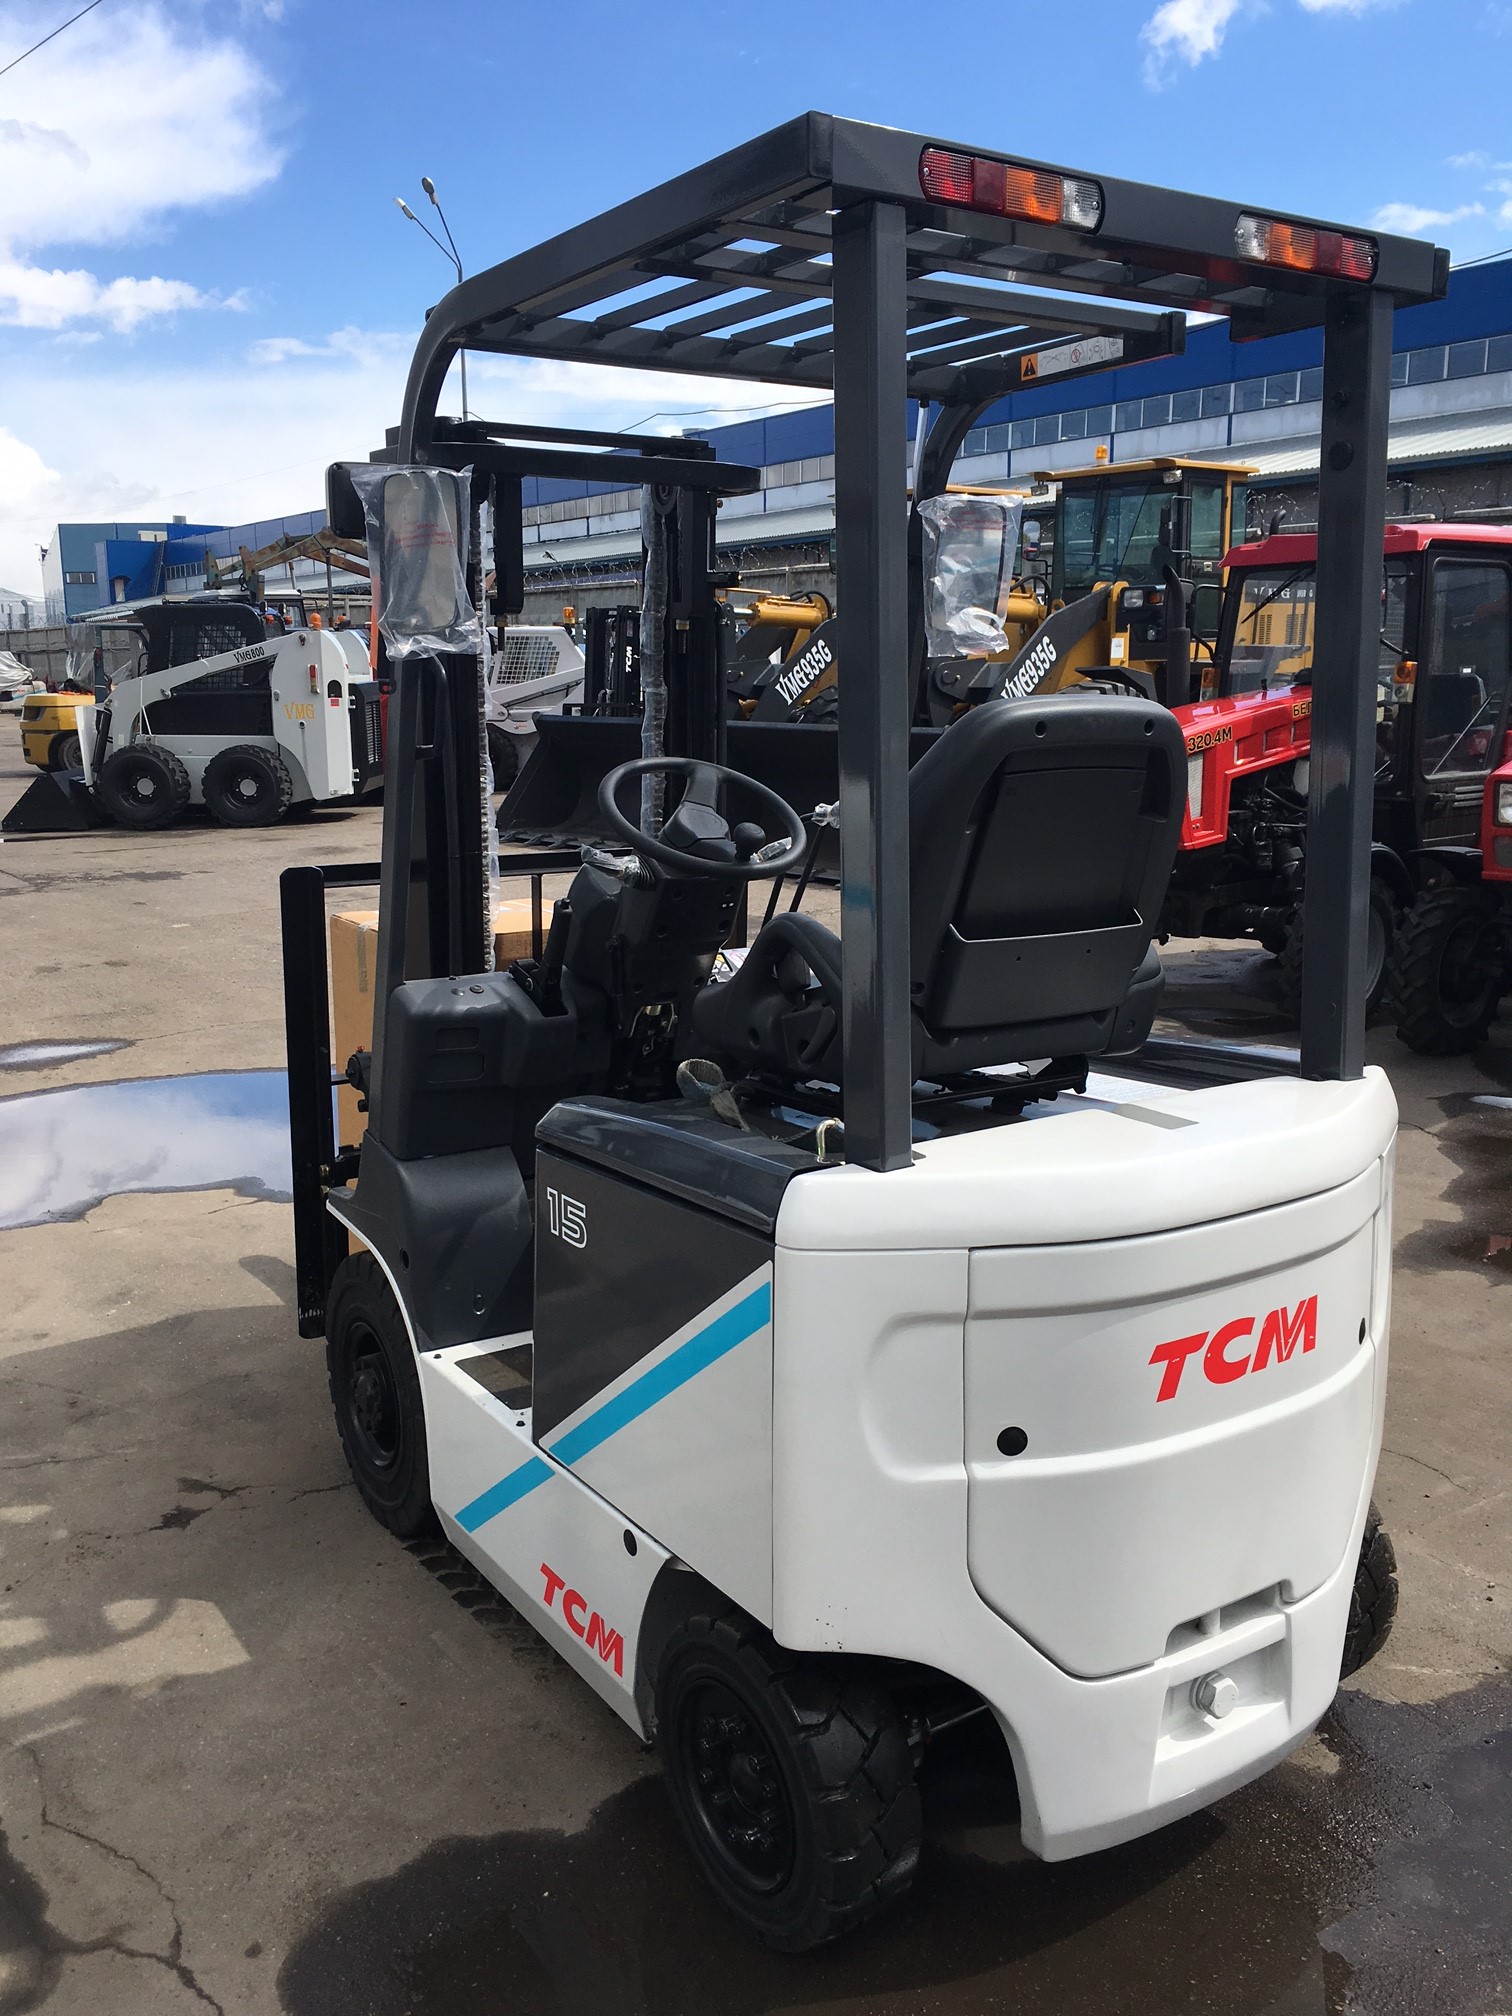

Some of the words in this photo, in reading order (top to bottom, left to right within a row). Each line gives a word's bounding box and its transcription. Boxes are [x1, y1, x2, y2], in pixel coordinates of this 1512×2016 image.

[233, 646, 265, 663] VMG800
[775, 639, 832, 706] VMG935G
[1000, 636, 1057, 699] VMG935G
[284, 701, 315, 719] VMG
[547, 1187, 587, 1248] 15
[1148, 1295, 1318, 1403] TCM
[540, 1562, 624, 1678] TCM
